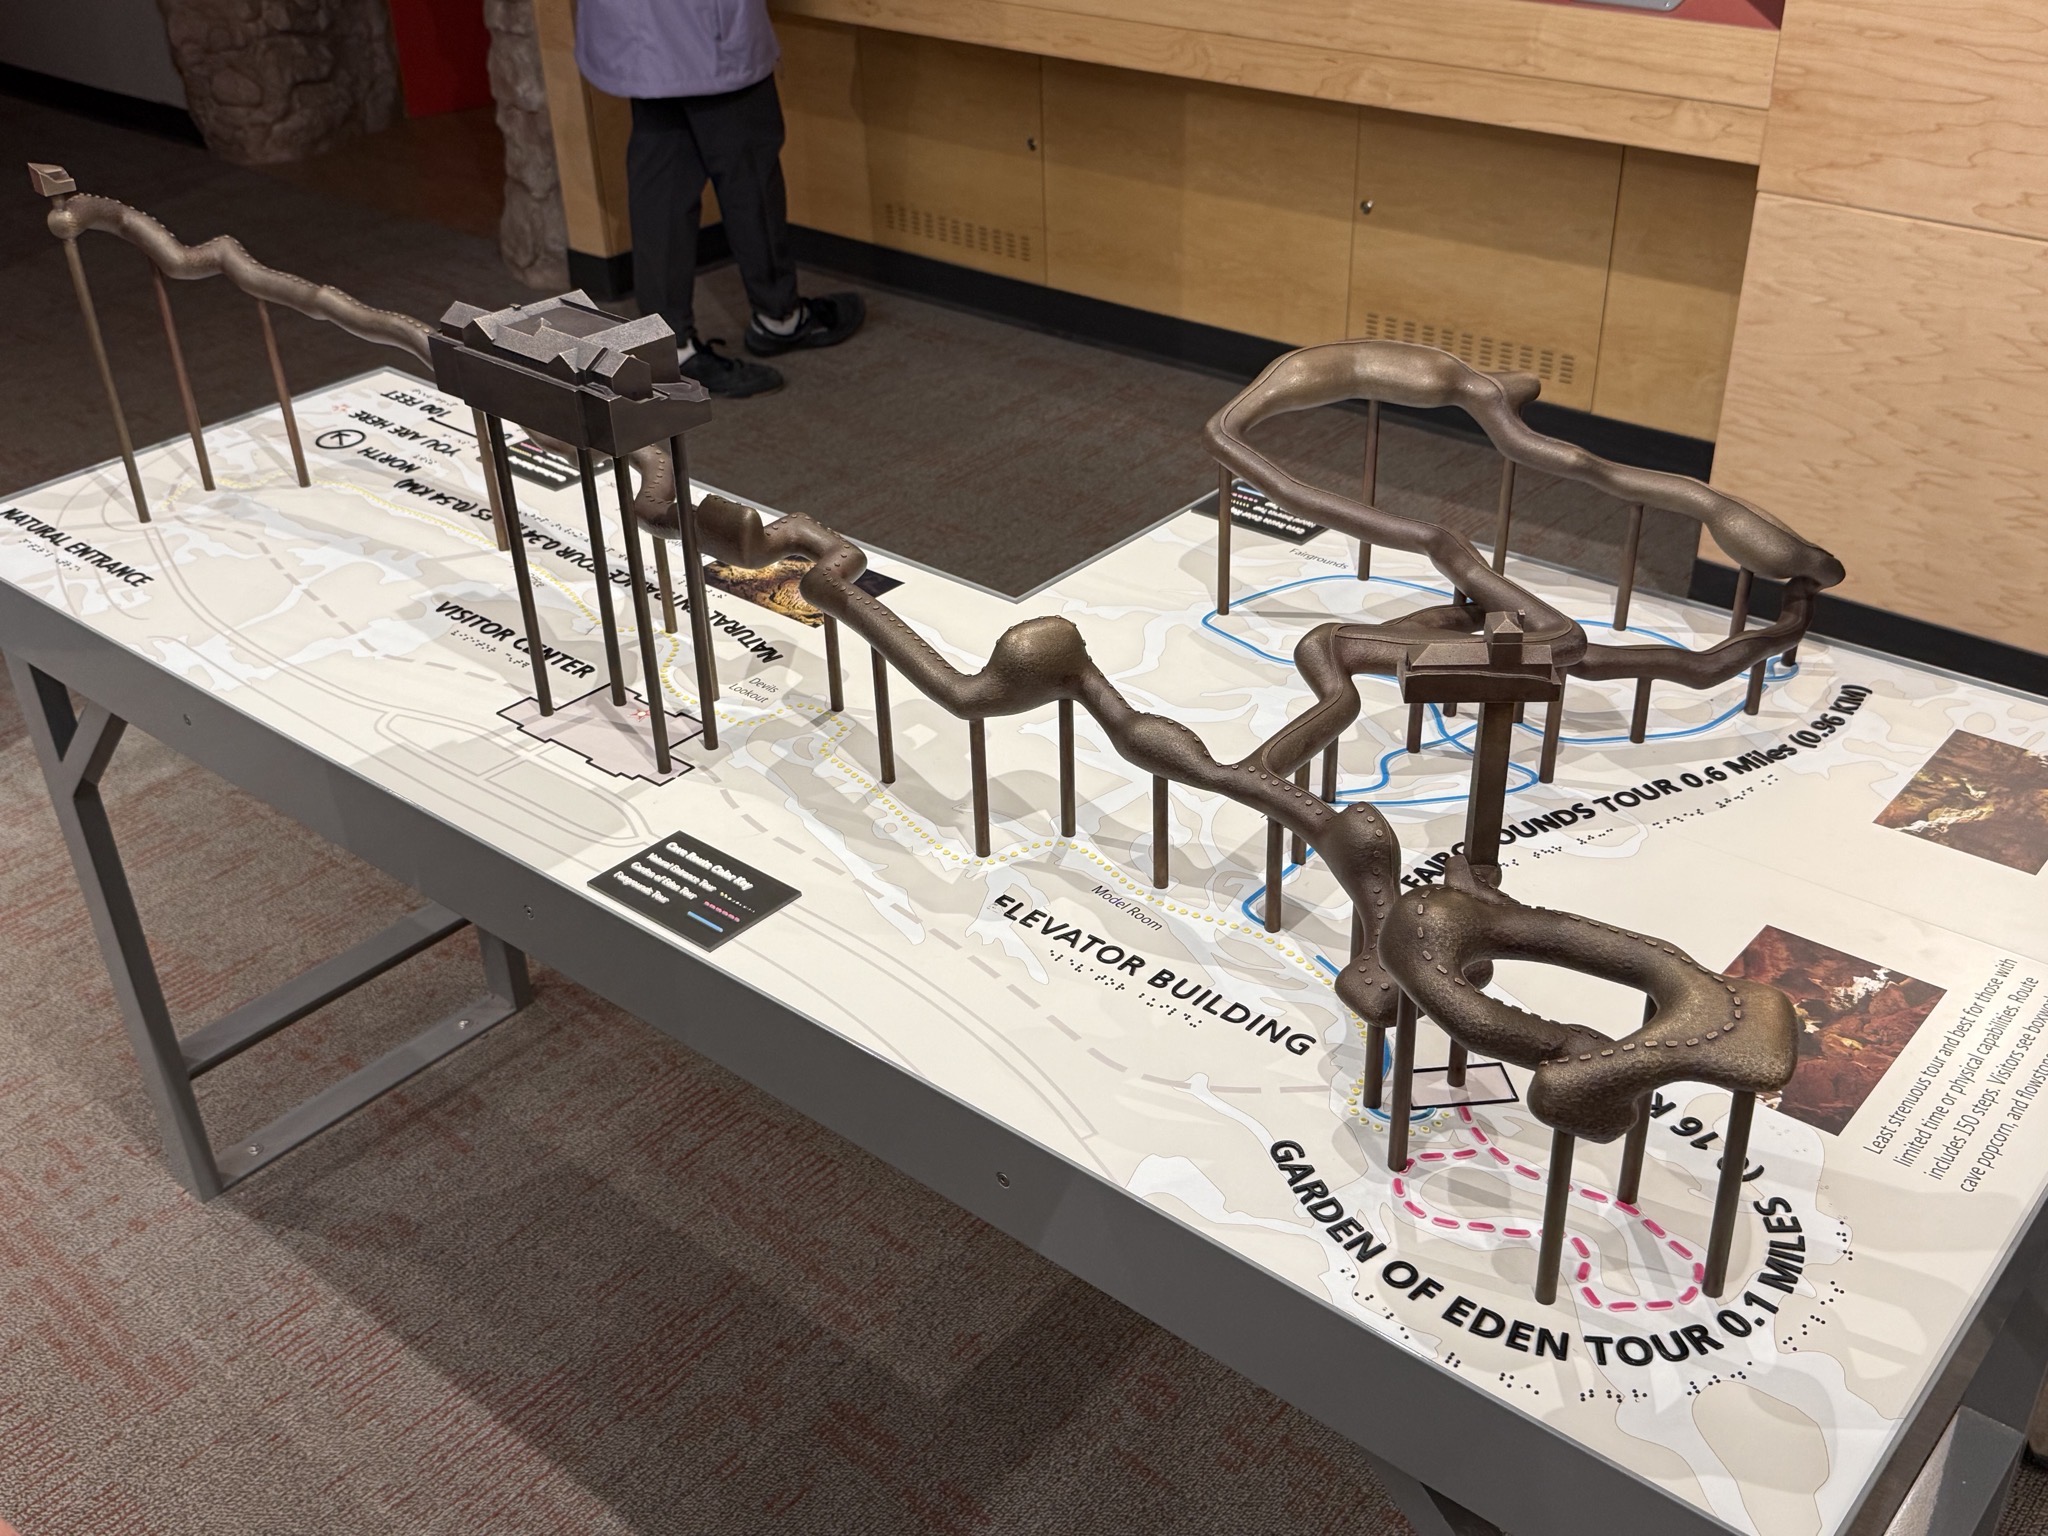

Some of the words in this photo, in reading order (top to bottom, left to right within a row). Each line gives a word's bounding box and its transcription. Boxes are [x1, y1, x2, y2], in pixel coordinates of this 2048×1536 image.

[380, 390, 420, 408] FEET
[420, 403, 452, 418] 100
[348, 409, 392, 430] HERE
[388, 425, 422, 441] ARE
[357, 446, 422, 474] NORTH
[421, 436, 462, 458] YOU
[0, 507, 72, 547] NATURAL
[64, 541, 155, 588] ENTRANCE
[1288, 547, 1349, 570] Fairgrounds
[435, 600, 516, 642] VISITOR
[708, 609, 784, 664] NATURAL
[728, 682, 769, 703] Lookout
[748, 677, 779, 693] Devils
[1592, 778, 1683, 814] TOUR
[1679, 765, 1728, 788] 0.6
[1722, 743, 1798, 775] Miles
[1788, 712, 1846, 749] (0.96
[1828, 684, 1873, 716] KM)
[1091, 884, 1127, 913] Model
[1127, 905, 1164, 932] Room
[994, 893, 1146, 977] ELEVATOR
[1146, 967, 1317, 1056] BUILDING
[2007, 976, 2039, 1006] Route
[1982, 1005, 2020, 1055] capabilities.
[2018, 1030, 2037, 1052] see
[1863, 1124, 1897, 1155] Least
[1891, 1076, 1932, 1127] strenuous
[1923, 1054, 1947, 1083] tour
[1938, 1030, 1960, 1057] and
[1953, 1015, 1974, 1040] best
[1964, 1000, 1985, 1022] for
[1976, 976, 2005, 1003] those
[1996, 957, 2018, 979] with
[1986, 1047, 2025, 1086] Visitors
[1949, 1051, 1986, 1096] physical
[1946, 1091, 1958, 1108] or
[1972, 1088, 2001, 1117] steps.
[1923, 1103, 1949, 1133] time
[1958, 1113, 1980, 1138] 150
[1893, 1126, 1933, 1168] limited
[1923, 1136, 1968, 1181] includes
[1960, 1165, 1986, 1194] cave
[1982, 1119, 2020, 1170] popcorn,
[2007, 1097, 2028, 1122] and
[1269, 1139, 1388, 1264] GARDEN
[1381, 1259, 1445, 1302] OF
[1441, 1295, 1570, 1362] EDEN
[1583, 1323, 1725, 1367] TOUR
[1717, 1290, 1780, 1338] 0.1
[1752, 1195, 1806, 1294] MILES
